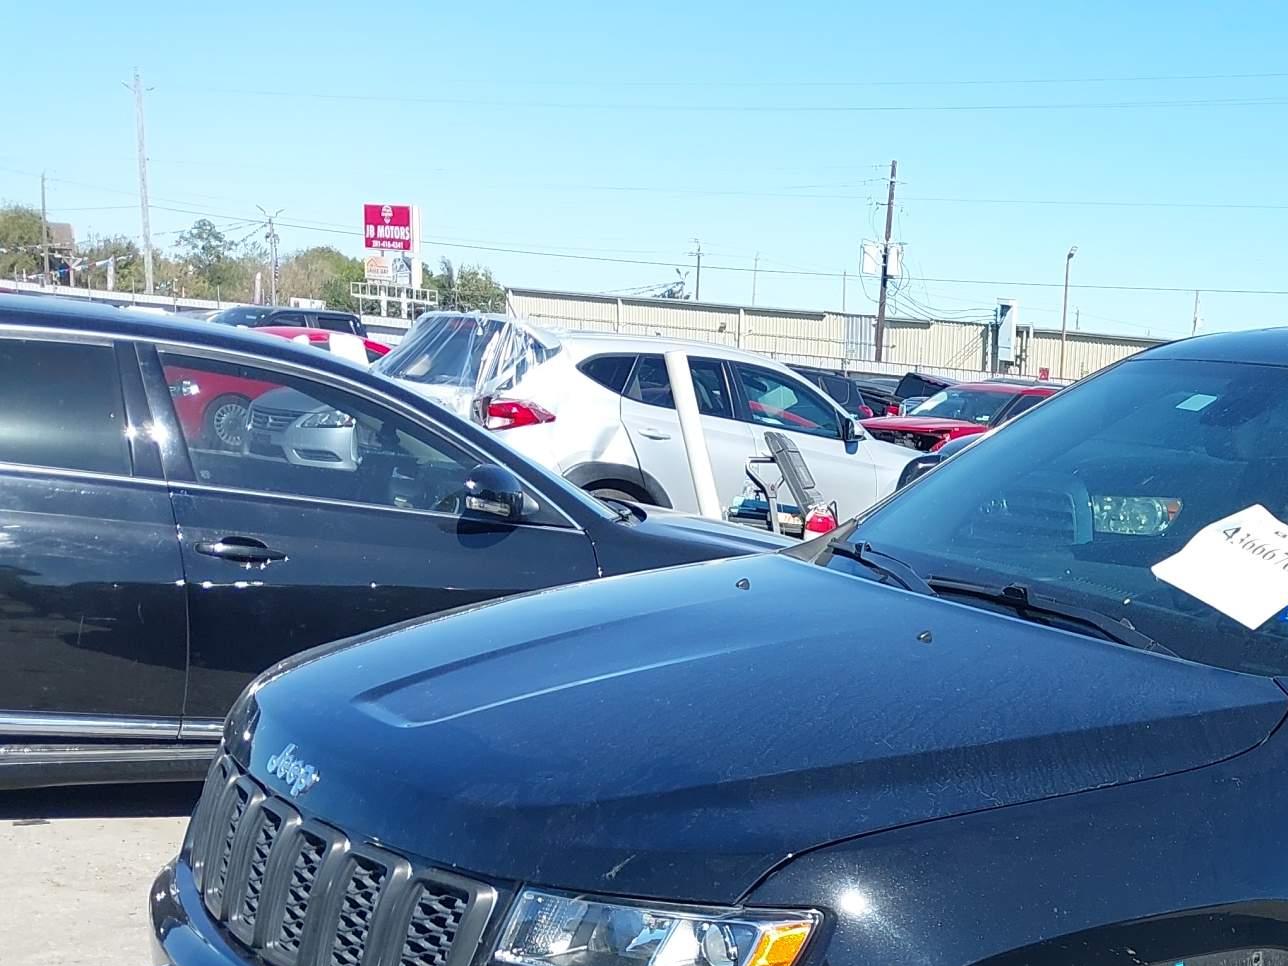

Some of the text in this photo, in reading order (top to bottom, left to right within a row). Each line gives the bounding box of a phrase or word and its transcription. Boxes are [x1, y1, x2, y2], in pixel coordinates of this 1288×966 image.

[366, 224, 410, 241] JB MOTORS
[267, 743, 319, 797] Jeep
